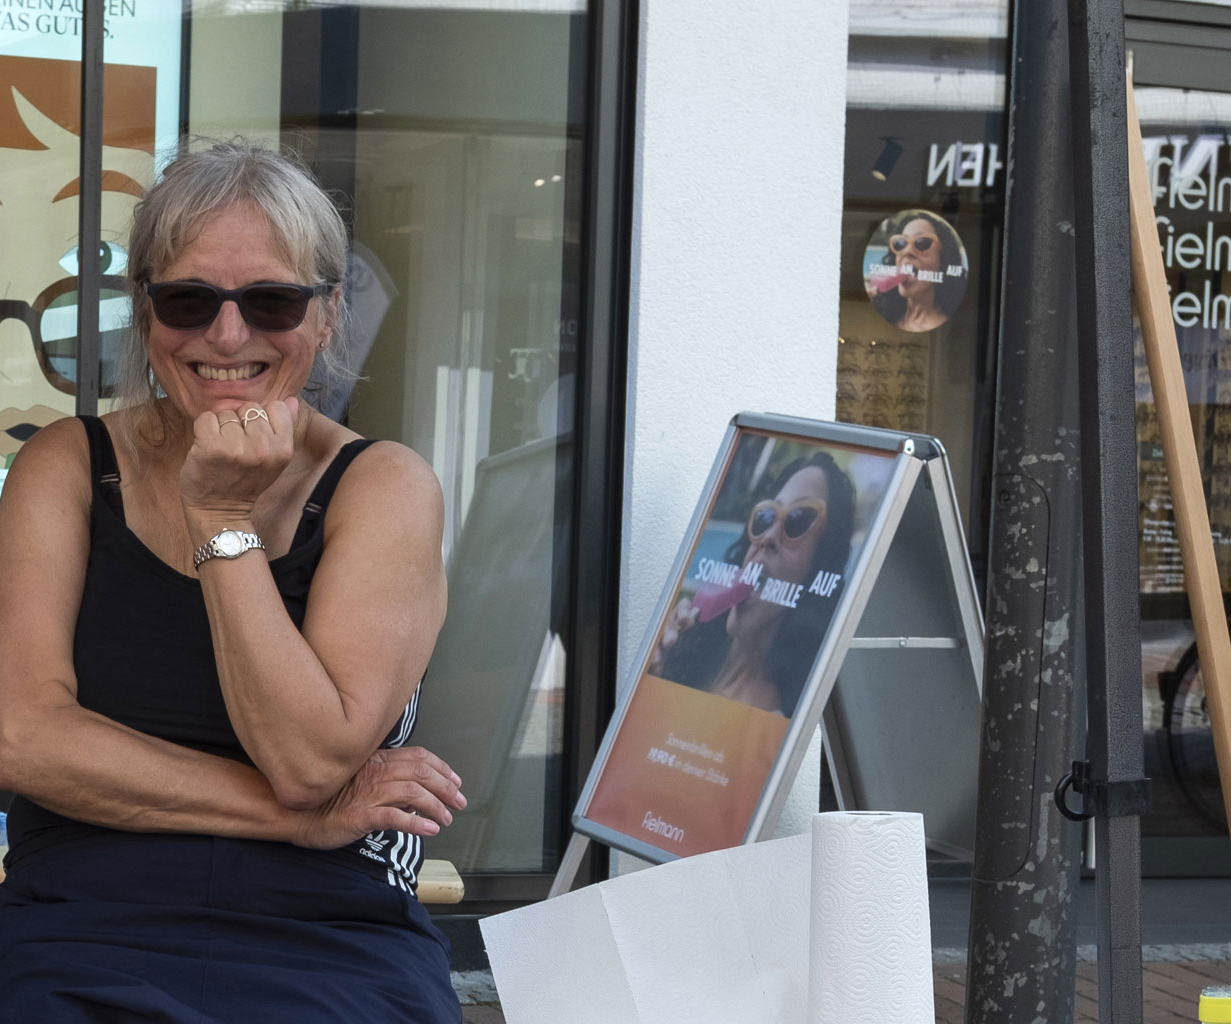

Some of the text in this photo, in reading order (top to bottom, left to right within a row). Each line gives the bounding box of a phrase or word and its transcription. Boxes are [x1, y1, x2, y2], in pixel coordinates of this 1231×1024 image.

[35, 14, 114, 39] GUTS.
[869, 264, 897, 277] SONNE
[918, 269, 943, 283] BRILLE
[946, 265, 963, 277] AUF
[694, 557, 841, 609] SONNE AN, BRILLE AUF
[642, 811, 684, 842] fielmann
